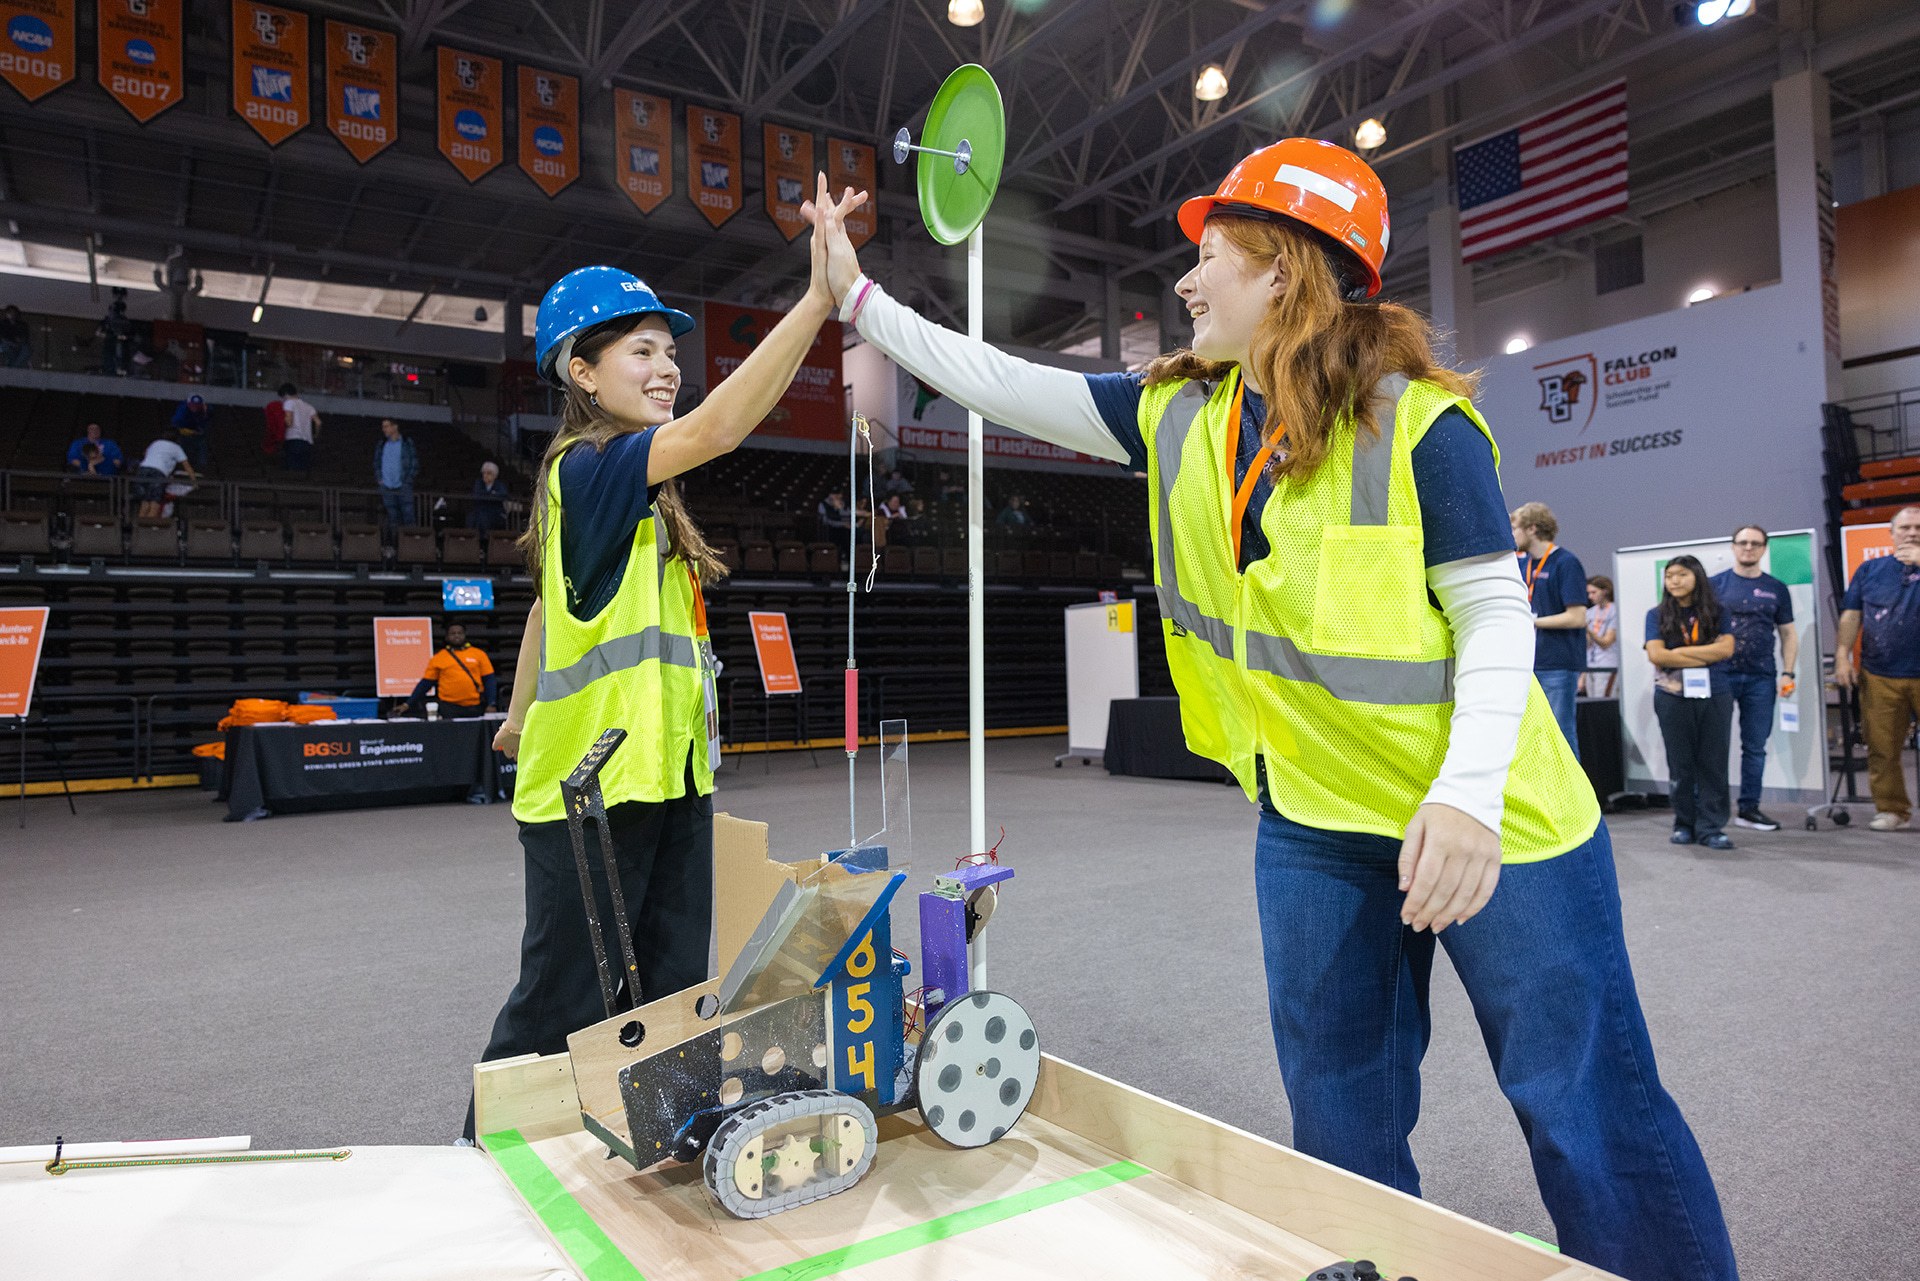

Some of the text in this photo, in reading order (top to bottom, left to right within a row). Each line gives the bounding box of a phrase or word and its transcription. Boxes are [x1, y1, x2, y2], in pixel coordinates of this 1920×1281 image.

[11, 30, 53, 48] NCAA
[0, 53, 62, 81] 2006
[112, 75, 171, 101] 2007
[246, 101, 299, 126] 2008
[338, 119, 387, 143] 2009
[451, 142, 491, 163] 2010
[533, 158, 566, 178] 2011
[628, 177, 662, 196] 2012
[701, 191, 733, 210] 2013
[1604, 346, 1677, 373] FALCON
[1605, 366, 1652, 386] CLUB
[1654, 380, 1672, 391] and
[902, 428, 939, 447] Order
[1535, 429, 1683, 468] INVEST IN SUCCESS
[384, 628, 422, 637] Volunteer
[386, 637, 422, 646] Check-In
[303, 741, 352, 757] BGSU
[360, 742, 423, 756] Engineering
[304, 757, 423, 771] BOWLING GREEN STATE UNIVERSITY
